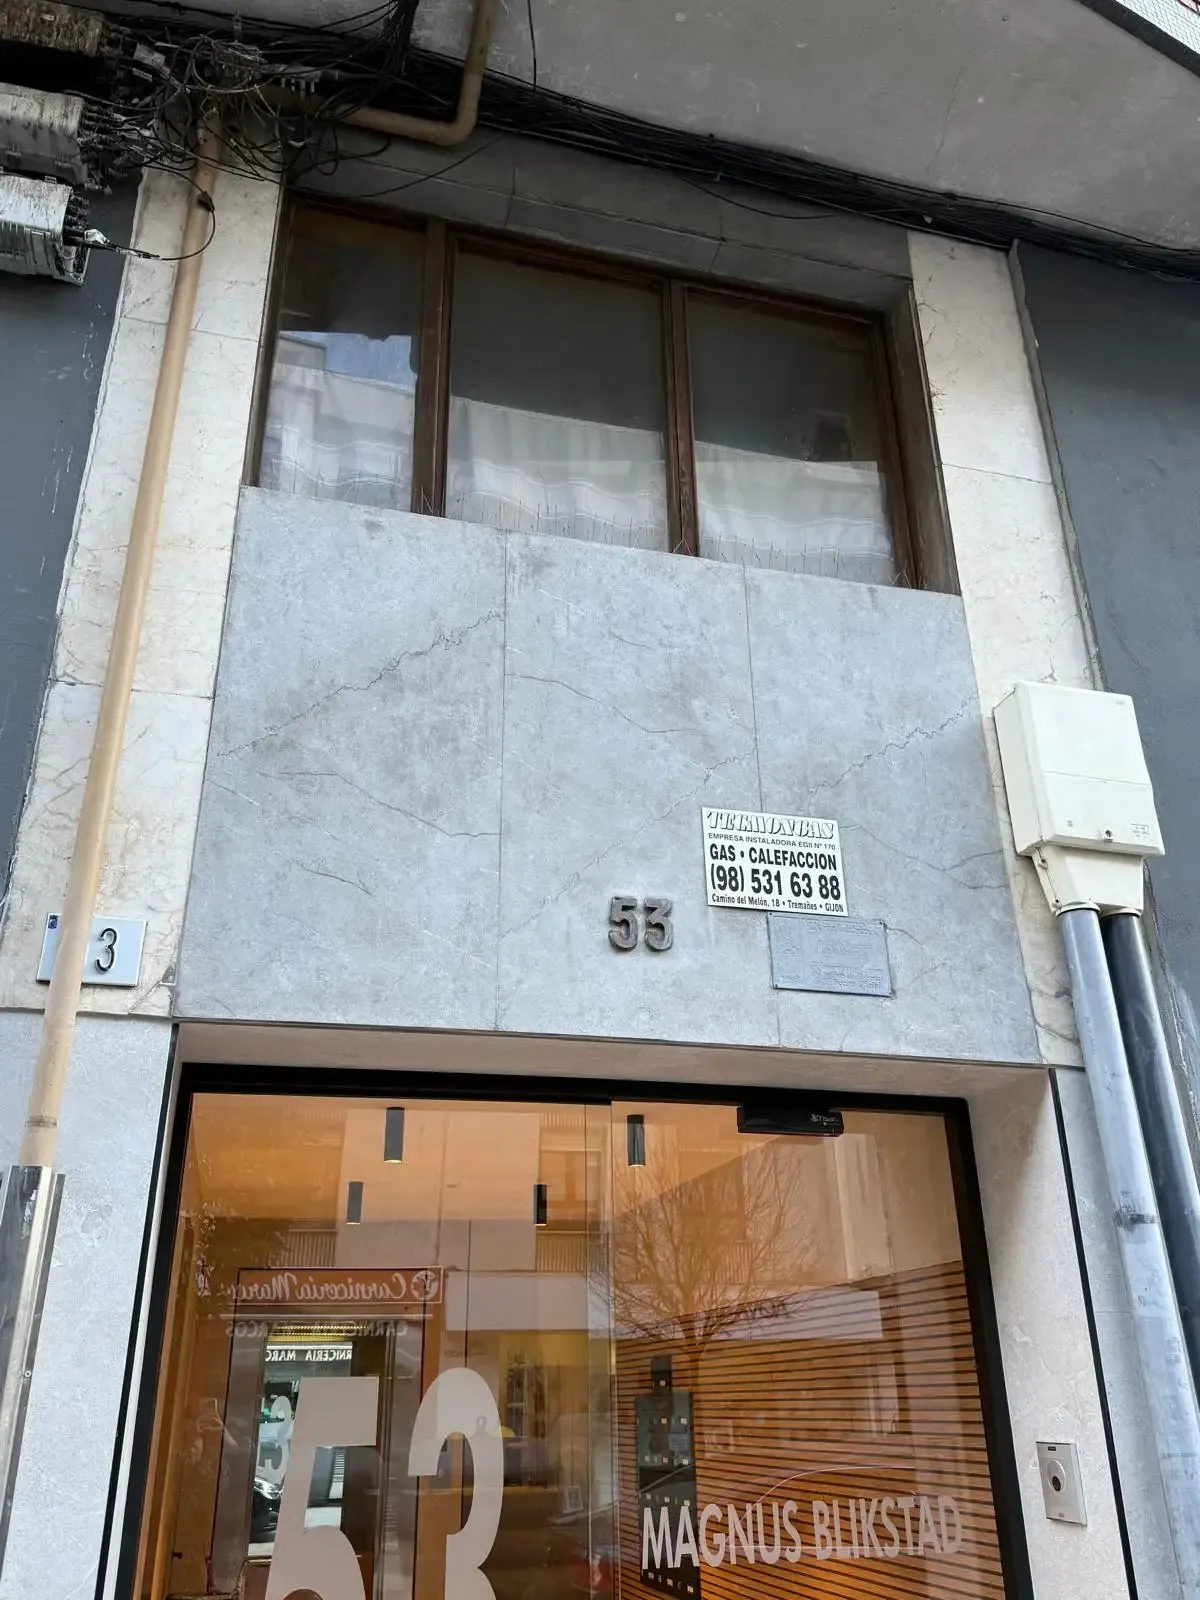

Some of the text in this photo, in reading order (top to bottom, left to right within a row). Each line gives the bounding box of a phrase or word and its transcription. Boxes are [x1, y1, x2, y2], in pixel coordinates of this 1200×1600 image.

[708, 833, 744, 843] EMPRESA
[745, 837, 797, 848] INSTALADORA
[710, 844, 838, 871] GAS CALEFACCION
[711, 863, 842, 901] (98) 531 63 88
[711, 893, 736, 904] Camino
[736, 895, 747, 904] del
[771, 899, 780, 908] 18
[787, 900, 818, 911] Tremañes
[608, 896, 674, 953] 53
[641, 1494, 964, 1570] MAGNUS BLIKSTAD
